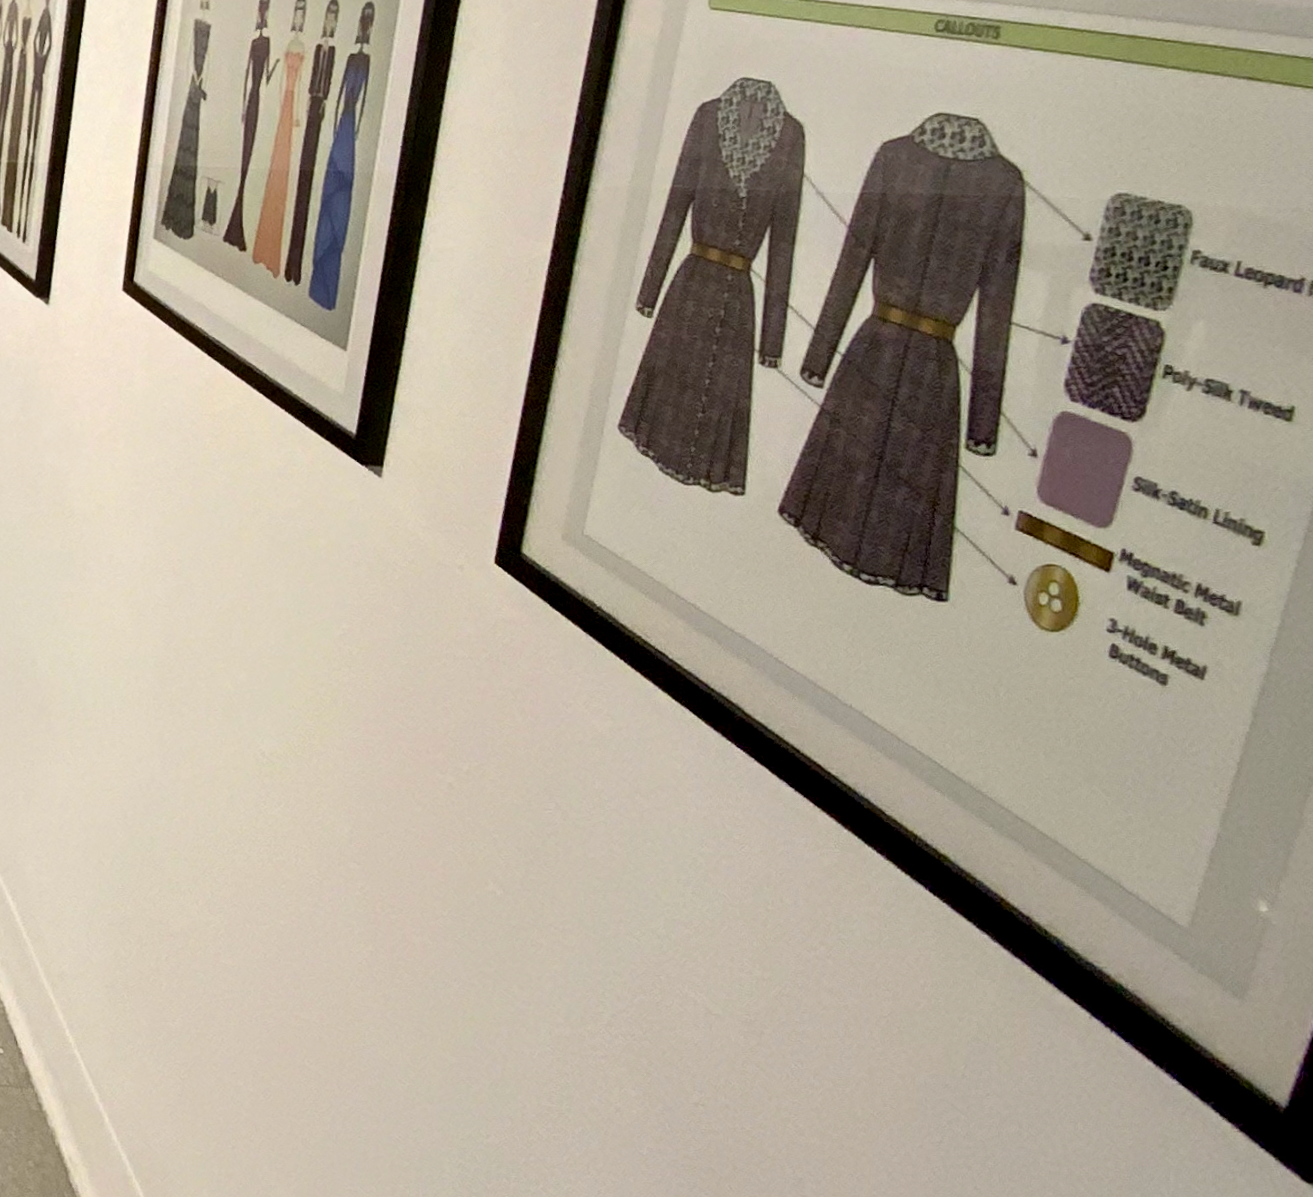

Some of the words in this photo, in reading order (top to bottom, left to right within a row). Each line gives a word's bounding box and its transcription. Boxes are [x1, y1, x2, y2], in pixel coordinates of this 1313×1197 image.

[935, 19, 1002, 40] CALLOUTS
[1190, 249, 1229, 274] Faux
[1234, 261, 1306, 293] Leopard
[1162, 364, 1233, 401] Poly-Silk
[1239, 389, 1295, 422] Tweed
[1132, 476, 1208, 519] Silk-Satin
[1213, 508, 1265, 546] Lining
[1119, 548, 1191, 593] Magnetic
[1194, 583, 1241, 616] Metal
[1127, 575, 1171, 609] Waist
[1174, 599, 1207, 626] Belt
[1106, 618, 1158, 655] 3-Hole
[1161, 646, 1207, 680] Metal
[1108, 643, 1168, 686] Buttons
